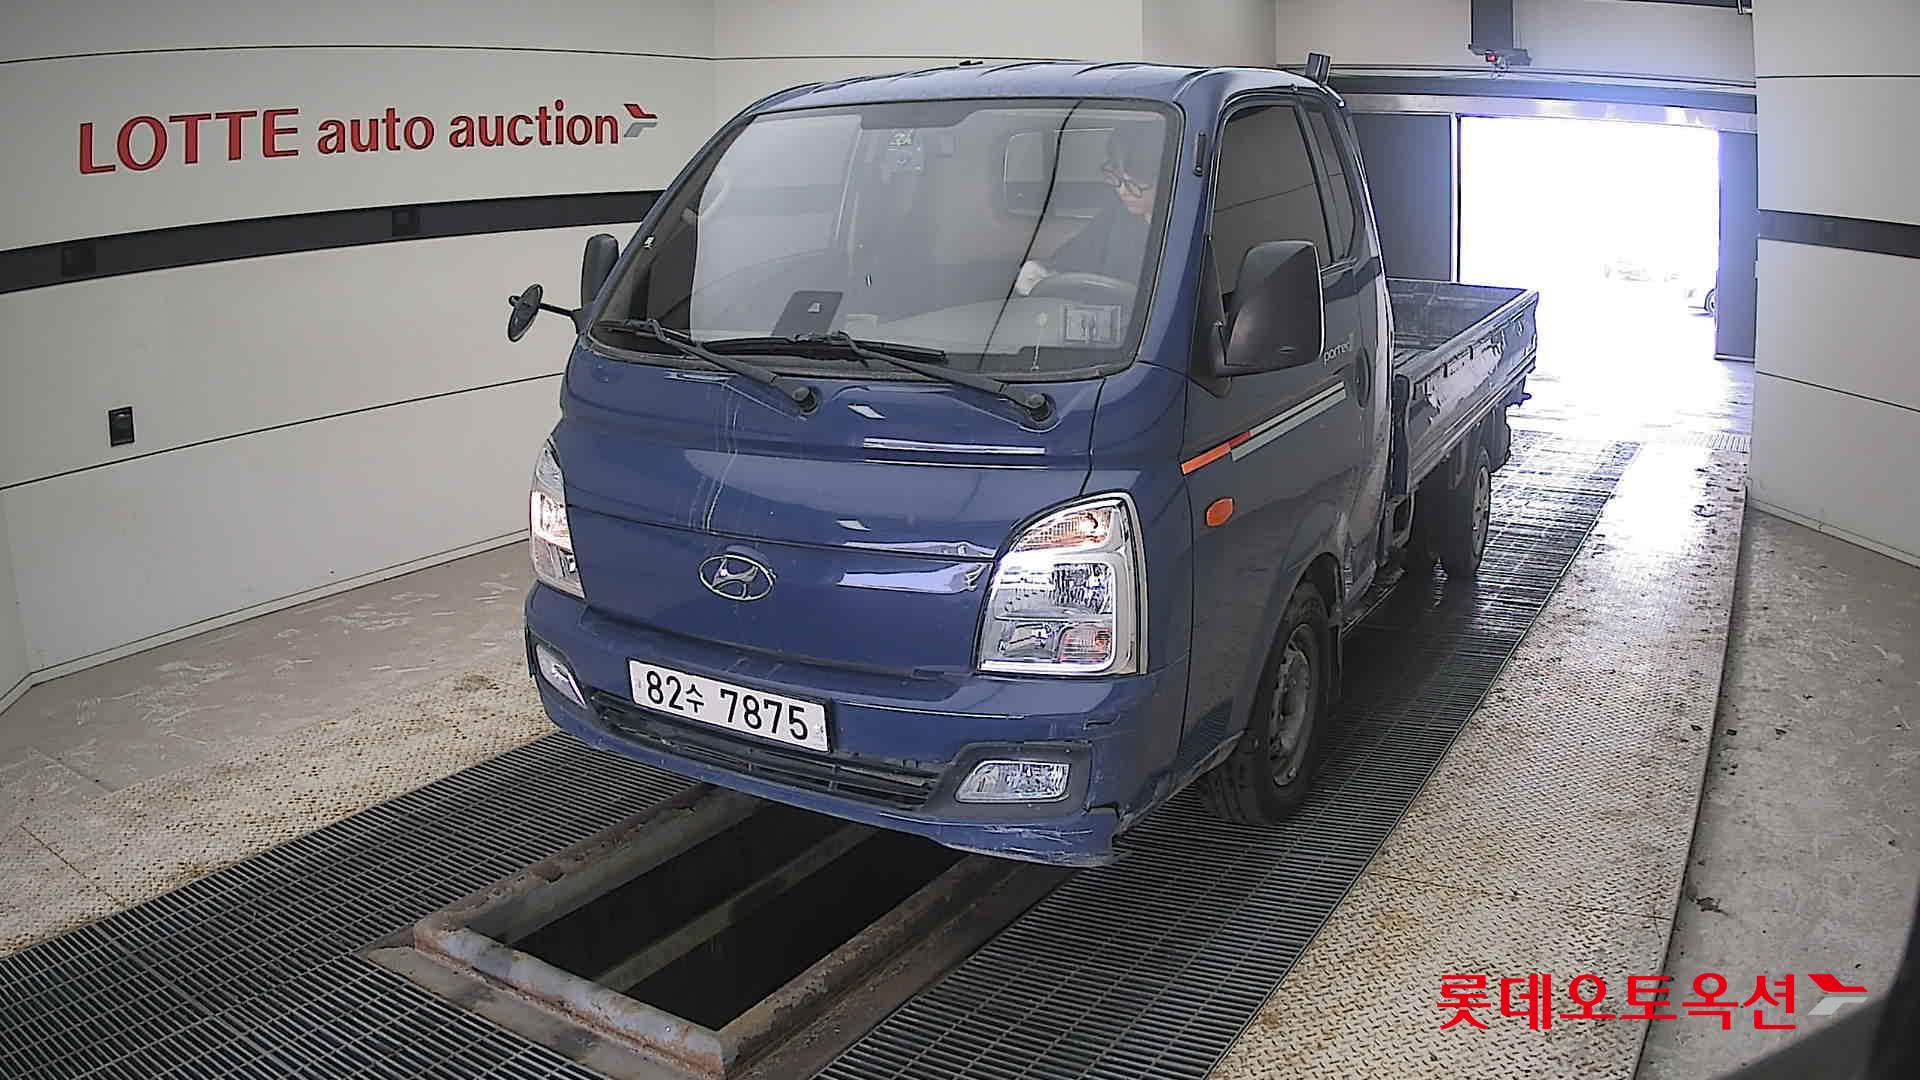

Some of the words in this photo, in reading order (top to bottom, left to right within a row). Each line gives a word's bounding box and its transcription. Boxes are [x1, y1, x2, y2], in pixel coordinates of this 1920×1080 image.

[80, 108, 299, 173] LOTTE
[318, 108, 434, 153] auto
[449, 100, 619, 147] auction
[646, 670, 705, 713] 82수
[720, 688, 808, 741] 7875
